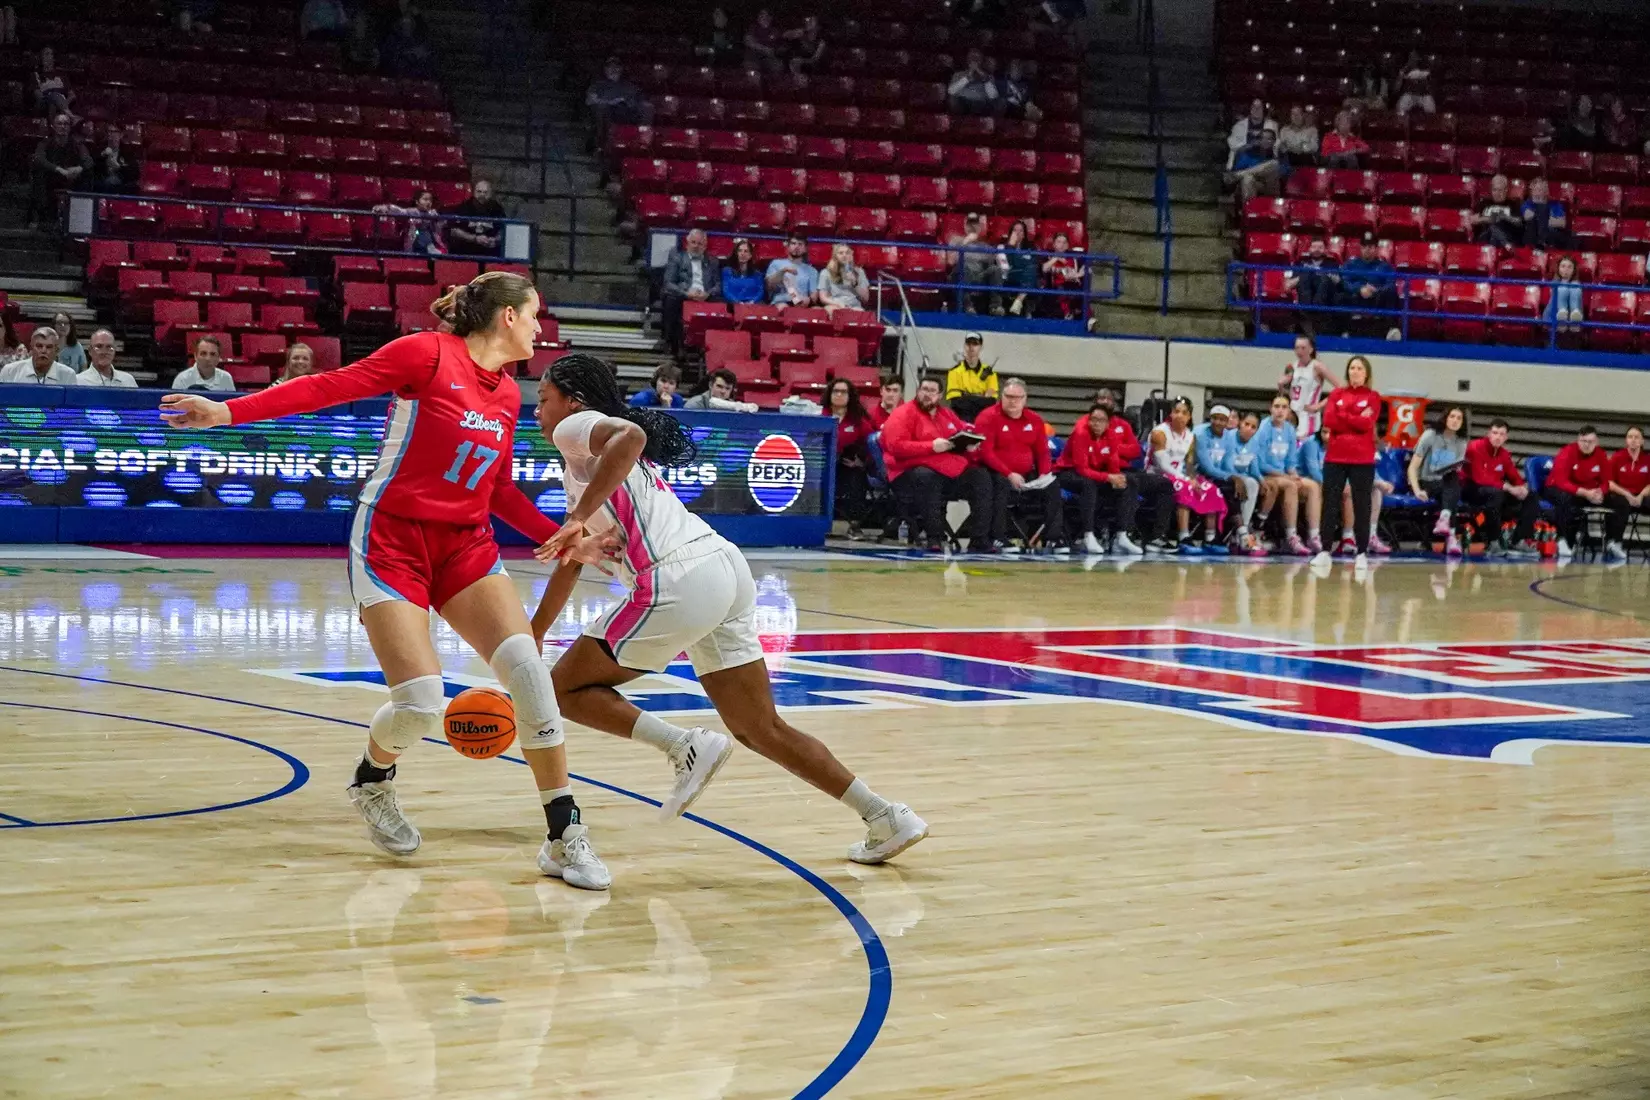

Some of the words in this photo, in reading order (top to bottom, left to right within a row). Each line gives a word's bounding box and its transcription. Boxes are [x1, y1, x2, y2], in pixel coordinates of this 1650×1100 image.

[460, 410, 504, 442] Liberty
[95, 449, 194, 472] SOFT
[200, 451, 325, 477] DRINK
[331, 453, 379, 478] OF
[443, 440, 500, 491] 17
[752, 466, 801, 481] PEPSI
[449, 720, 499, 734] Wilson
